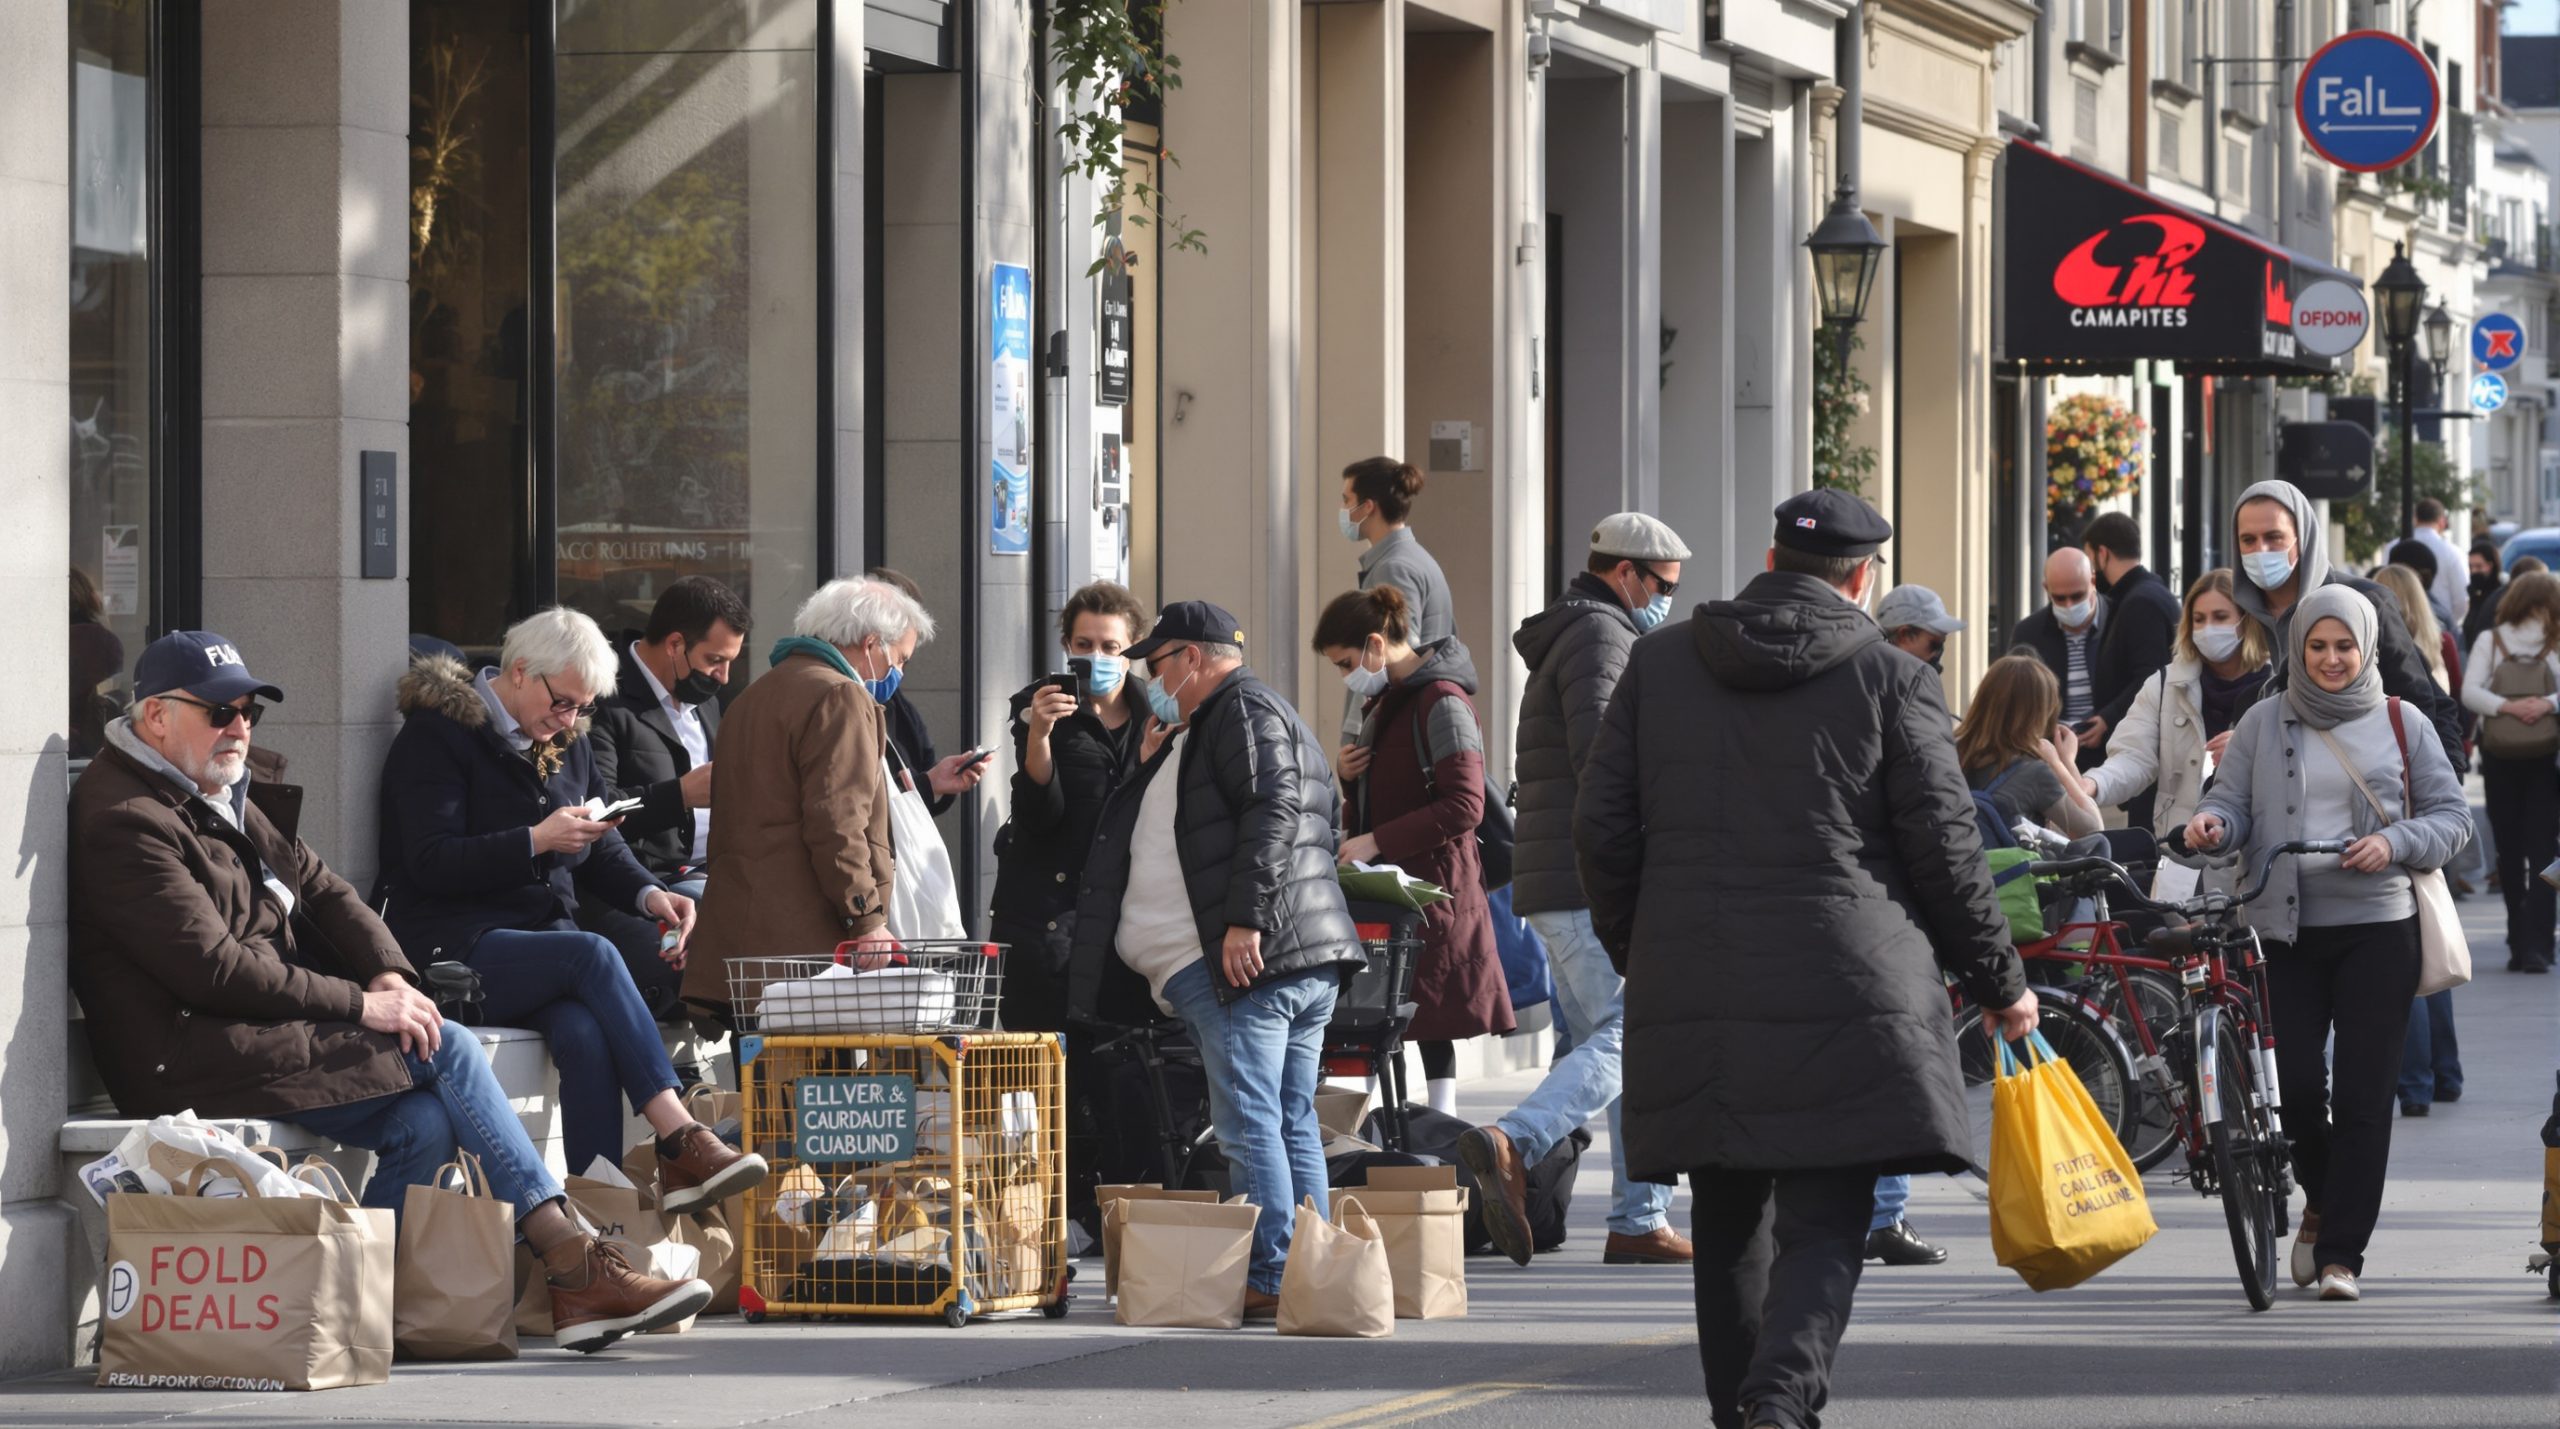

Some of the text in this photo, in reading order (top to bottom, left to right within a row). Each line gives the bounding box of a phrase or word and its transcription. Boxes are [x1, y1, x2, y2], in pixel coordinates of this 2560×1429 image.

[2070, 307, 2188, 328] CAMAPITES
[805, 1133, 900, 1156] CUABUND
[151, 1245, 267, 1286] FOLD
[142, 1294, 280, 1332] DEALS
